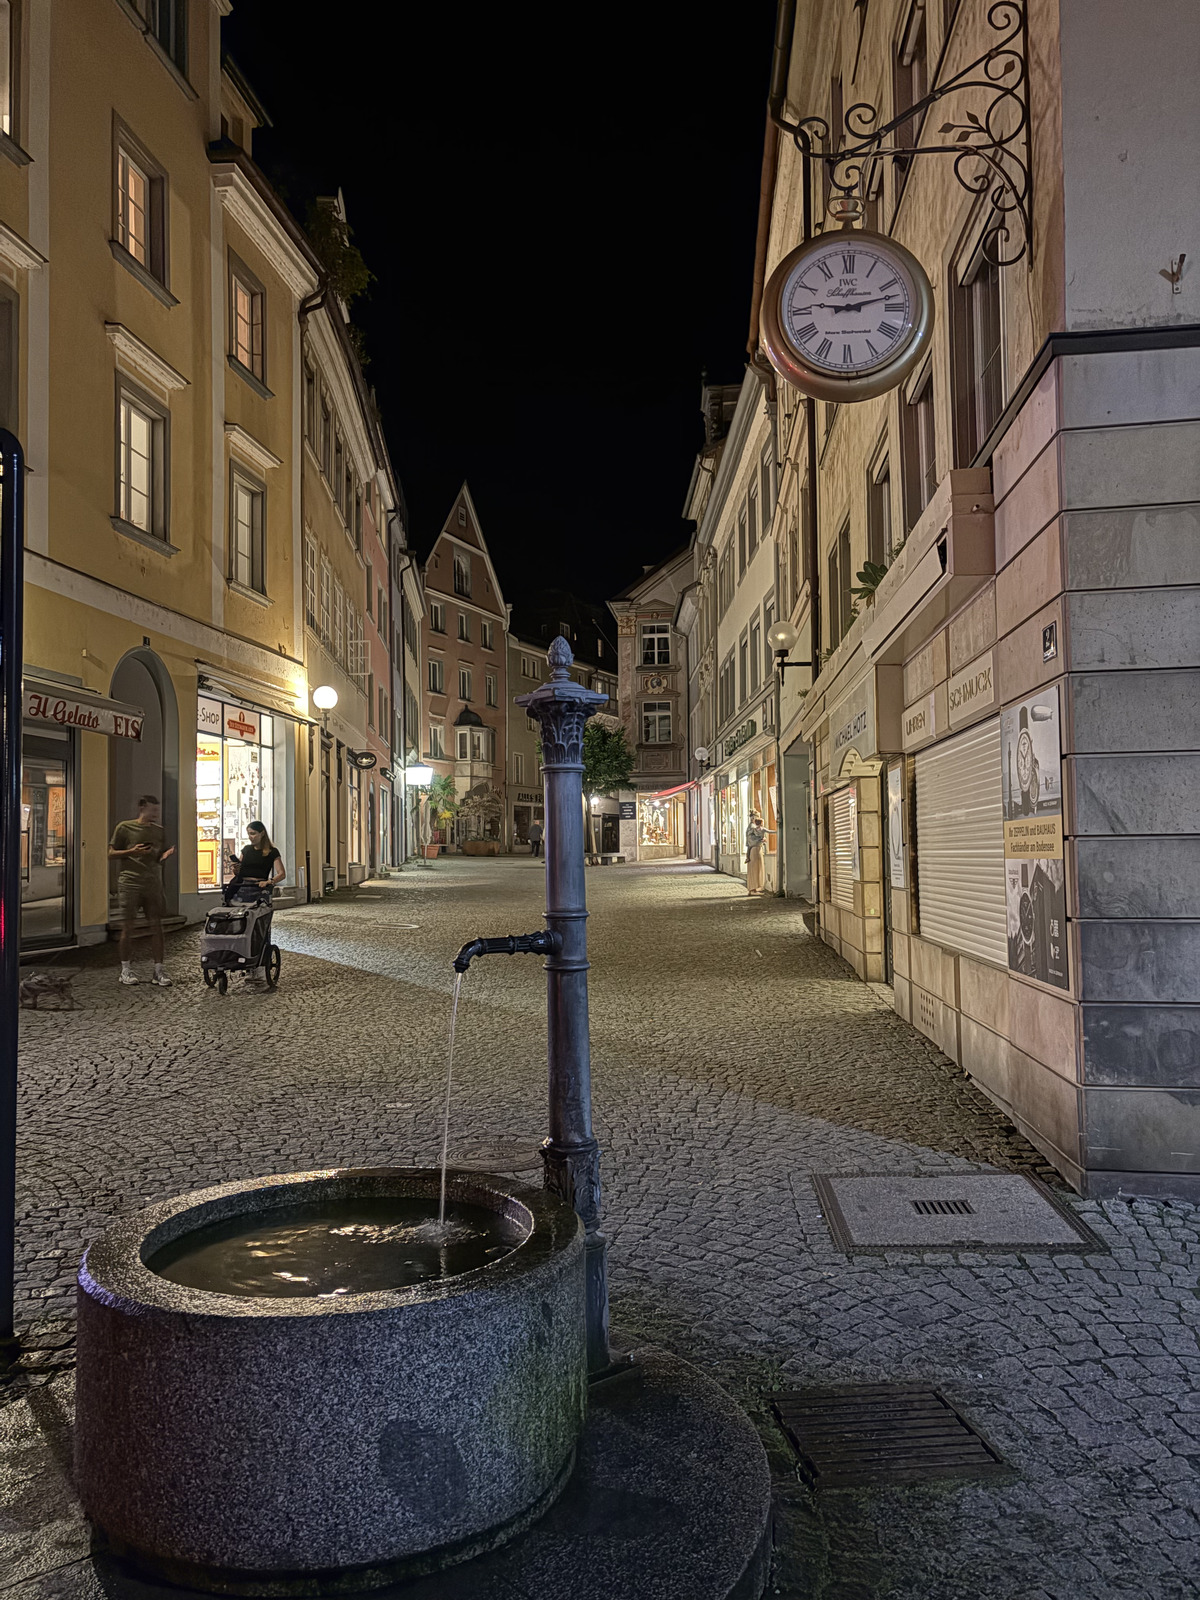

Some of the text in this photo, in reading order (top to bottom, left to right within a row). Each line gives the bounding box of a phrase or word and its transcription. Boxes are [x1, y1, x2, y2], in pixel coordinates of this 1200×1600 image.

[839, 278, 857, 287] IWC
[949, 667, 992, 711] SCHMUCK
[51, 700, 100, 729] Gelato
[112, 714, 141, 740] EIS
[905, 710, 926, 736] UHREN
[1013, 825, 1029, 838] ZEPPELIN
[1036, 822, 1056, 836] BAUHAUS
[1036, 840, 1054, 852] Bodensee
